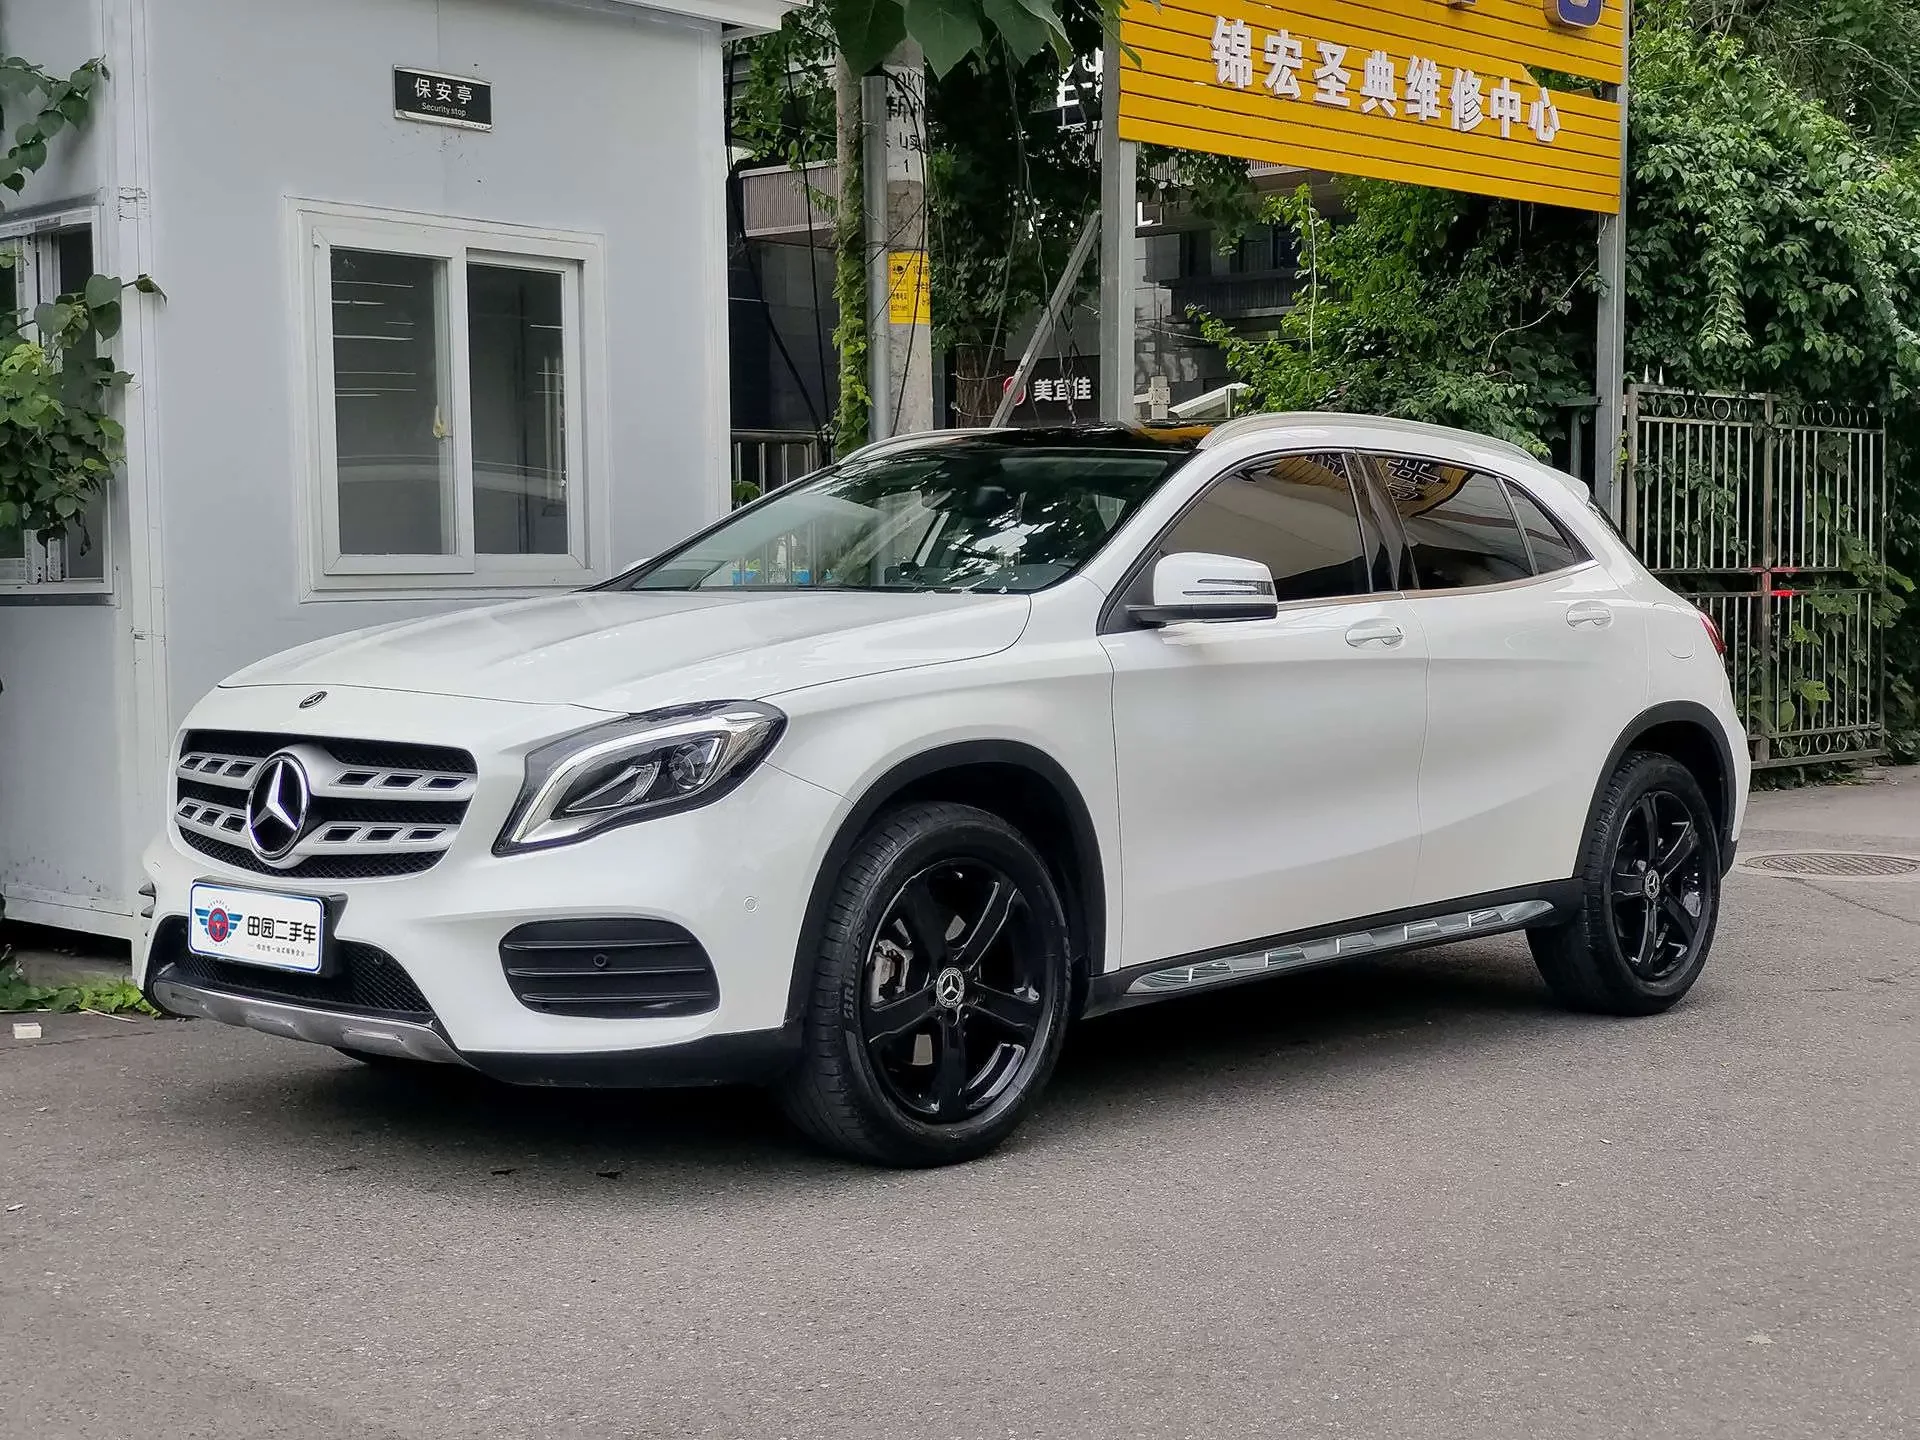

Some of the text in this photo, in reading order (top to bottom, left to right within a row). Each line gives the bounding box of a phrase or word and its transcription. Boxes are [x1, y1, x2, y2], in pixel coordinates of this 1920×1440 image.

[414, 78, 472, 104] 保安亭
[1211, 15, 1560, 142] 锦宏圣典维修中心
[422, 102, 467, 117] Security stop
[1034, 377, 1091, 402] 美宜佳
[247, 916, 316, 944] 田园二手车
